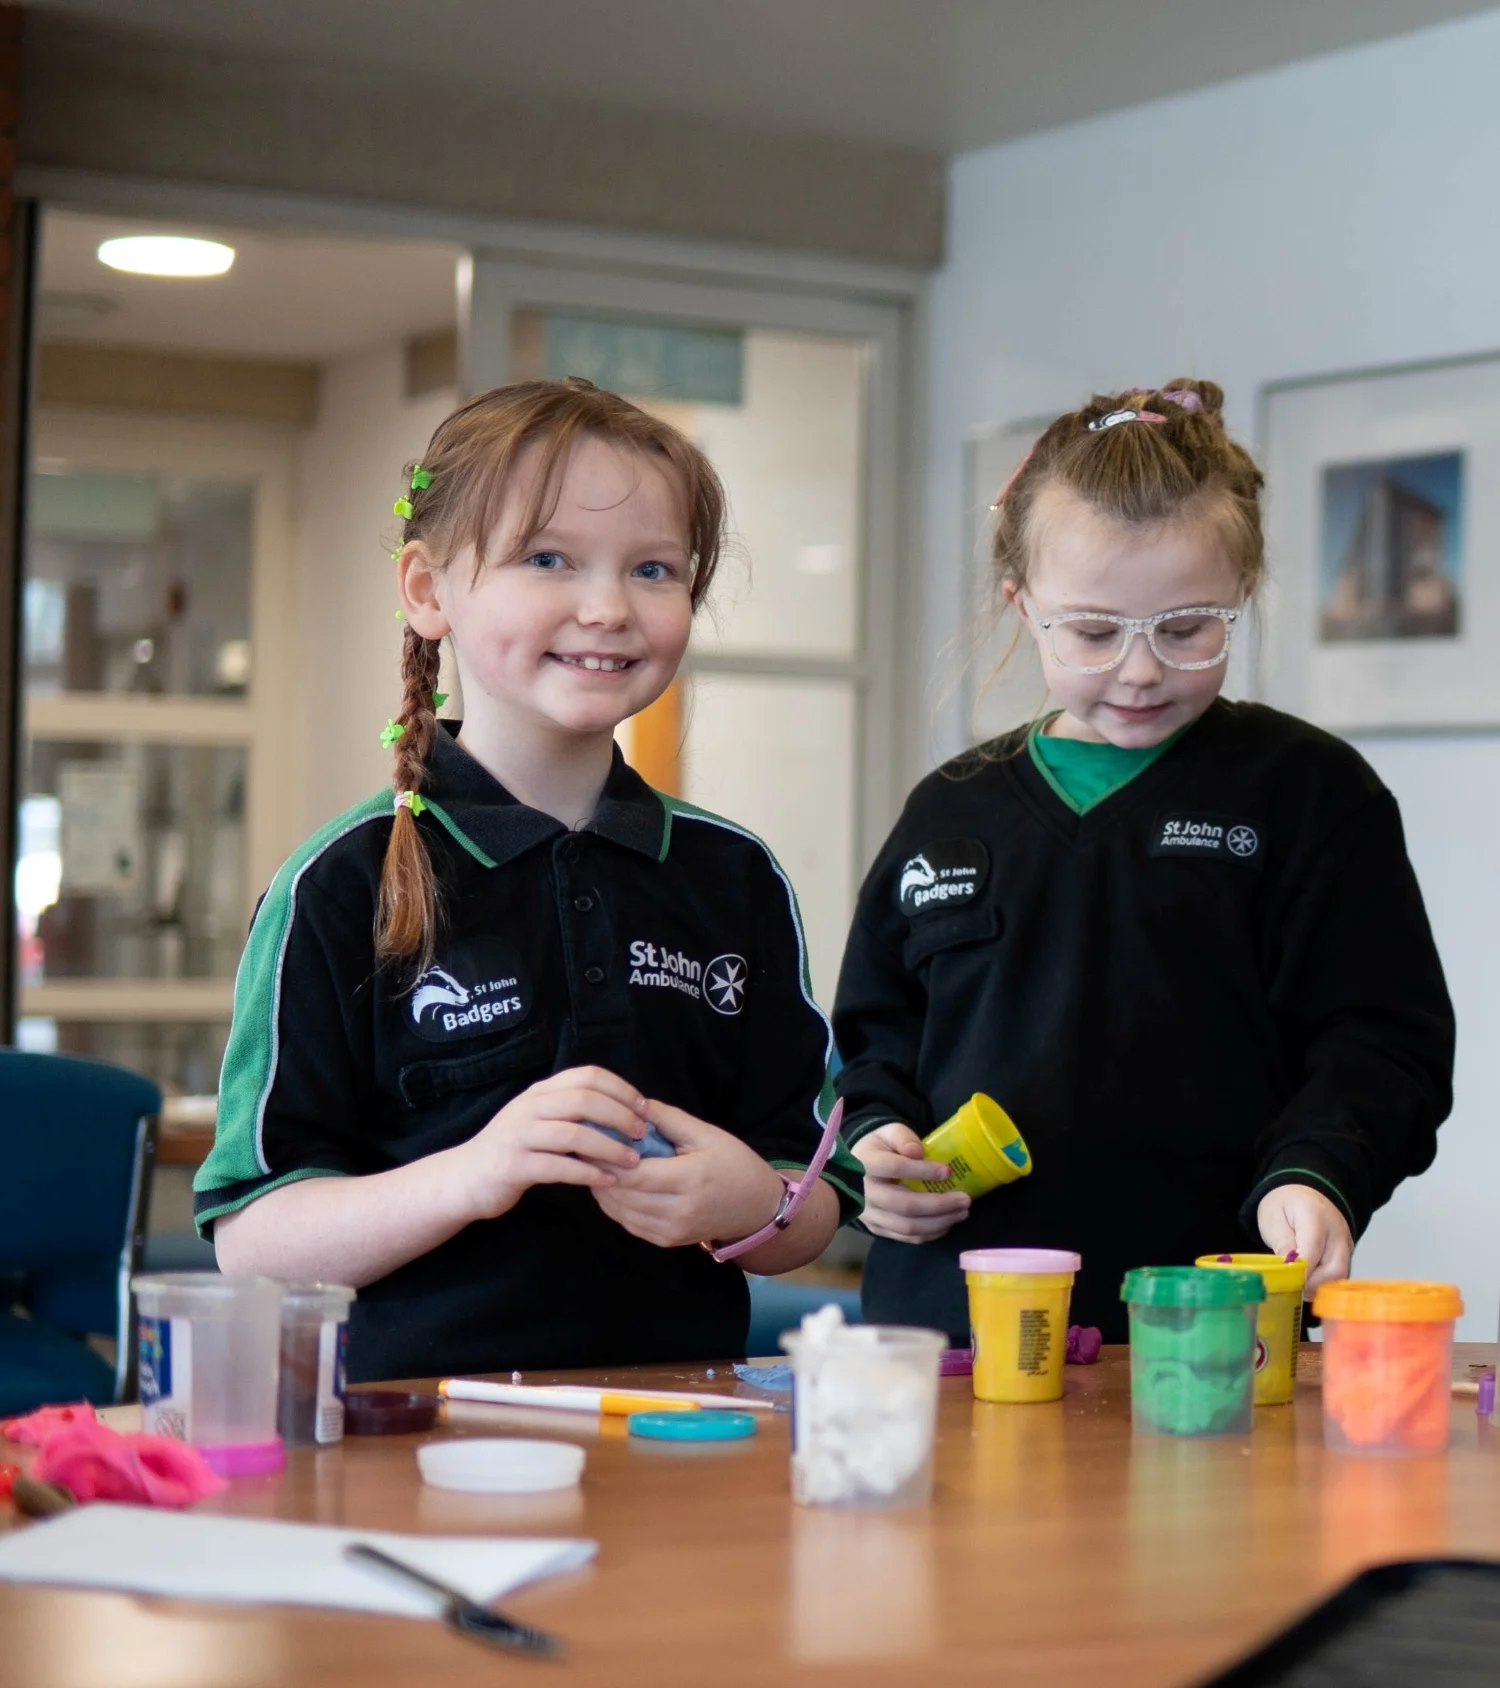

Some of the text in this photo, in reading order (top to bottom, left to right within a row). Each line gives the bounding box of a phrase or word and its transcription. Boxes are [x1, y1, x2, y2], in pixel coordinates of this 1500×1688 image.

[1163, 820, 1223, 838] St John
[1160, 835, 1220, 849] Ambulance
[940, 867, 977, 879] St John
[914, 882, 974, 908] Badgers
[629, 940, 701, 982] St John
[474, 977, 517, 996] St John
[629, 969, 700, 999] Ambulance
[443, 996, 522, 1031] Badgers
